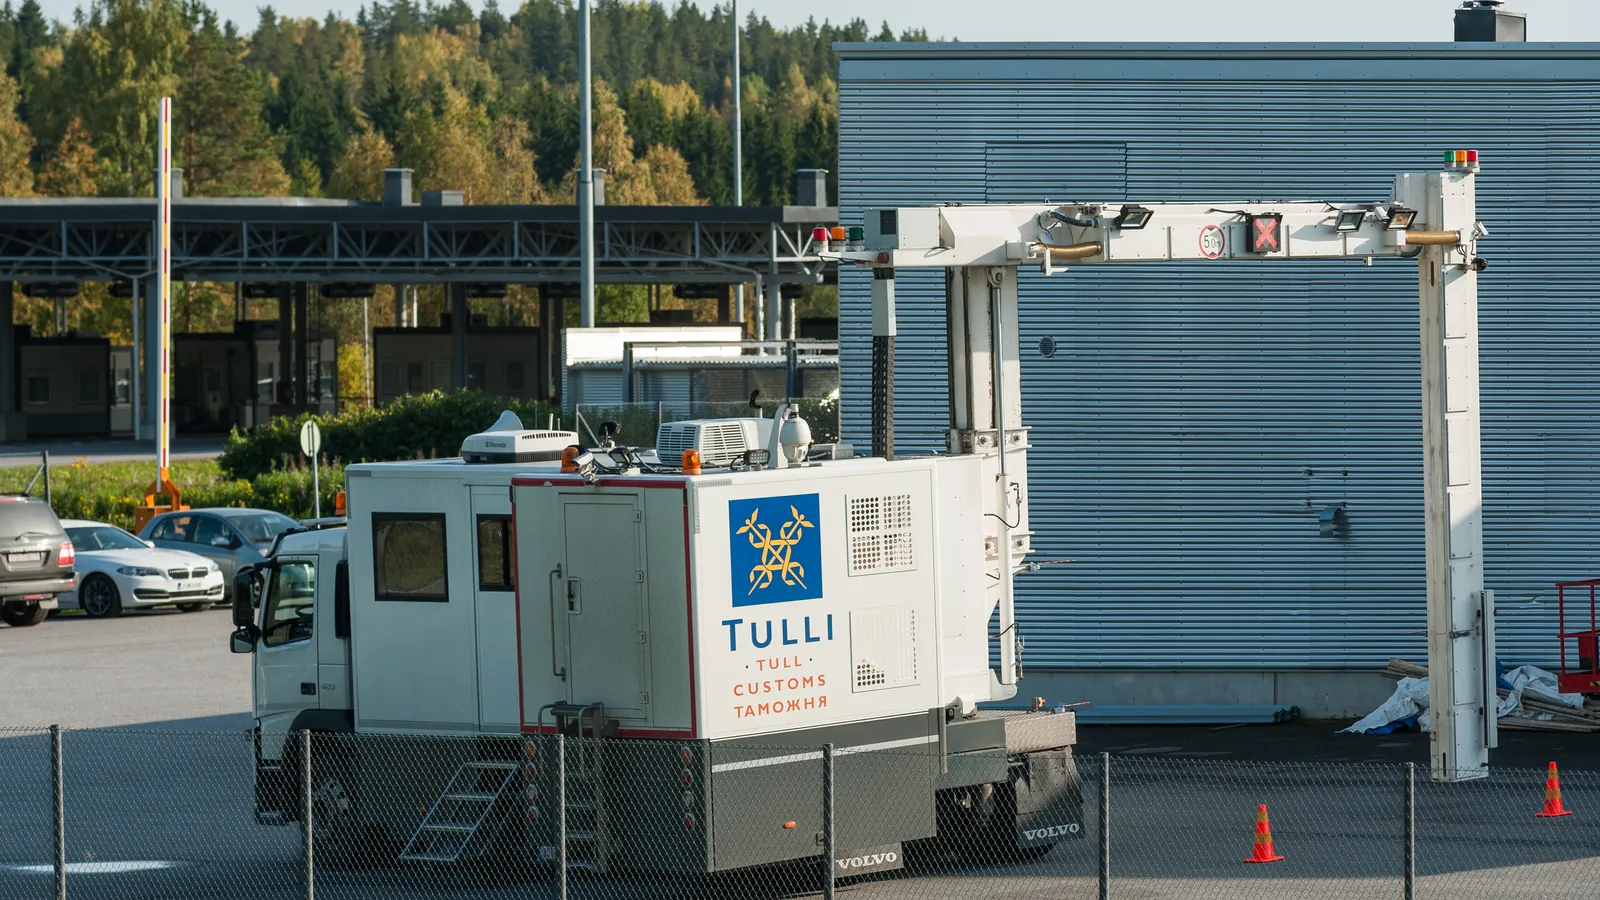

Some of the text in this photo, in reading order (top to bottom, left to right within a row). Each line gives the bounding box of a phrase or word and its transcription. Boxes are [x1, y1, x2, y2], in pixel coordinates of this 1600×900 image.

[489, 441, 507, 449] Dometic
[721, 614, 833, 652] TULLI
[756, 655, 802, 671] TULL
[732, 674, 827, 697] CUSTOMS
[733, 695, 828, 719] ТАМОЖНЯ
[1023, 823, 1080, 841] VOLVO
[836, 852, 897, 870] VOLVO
